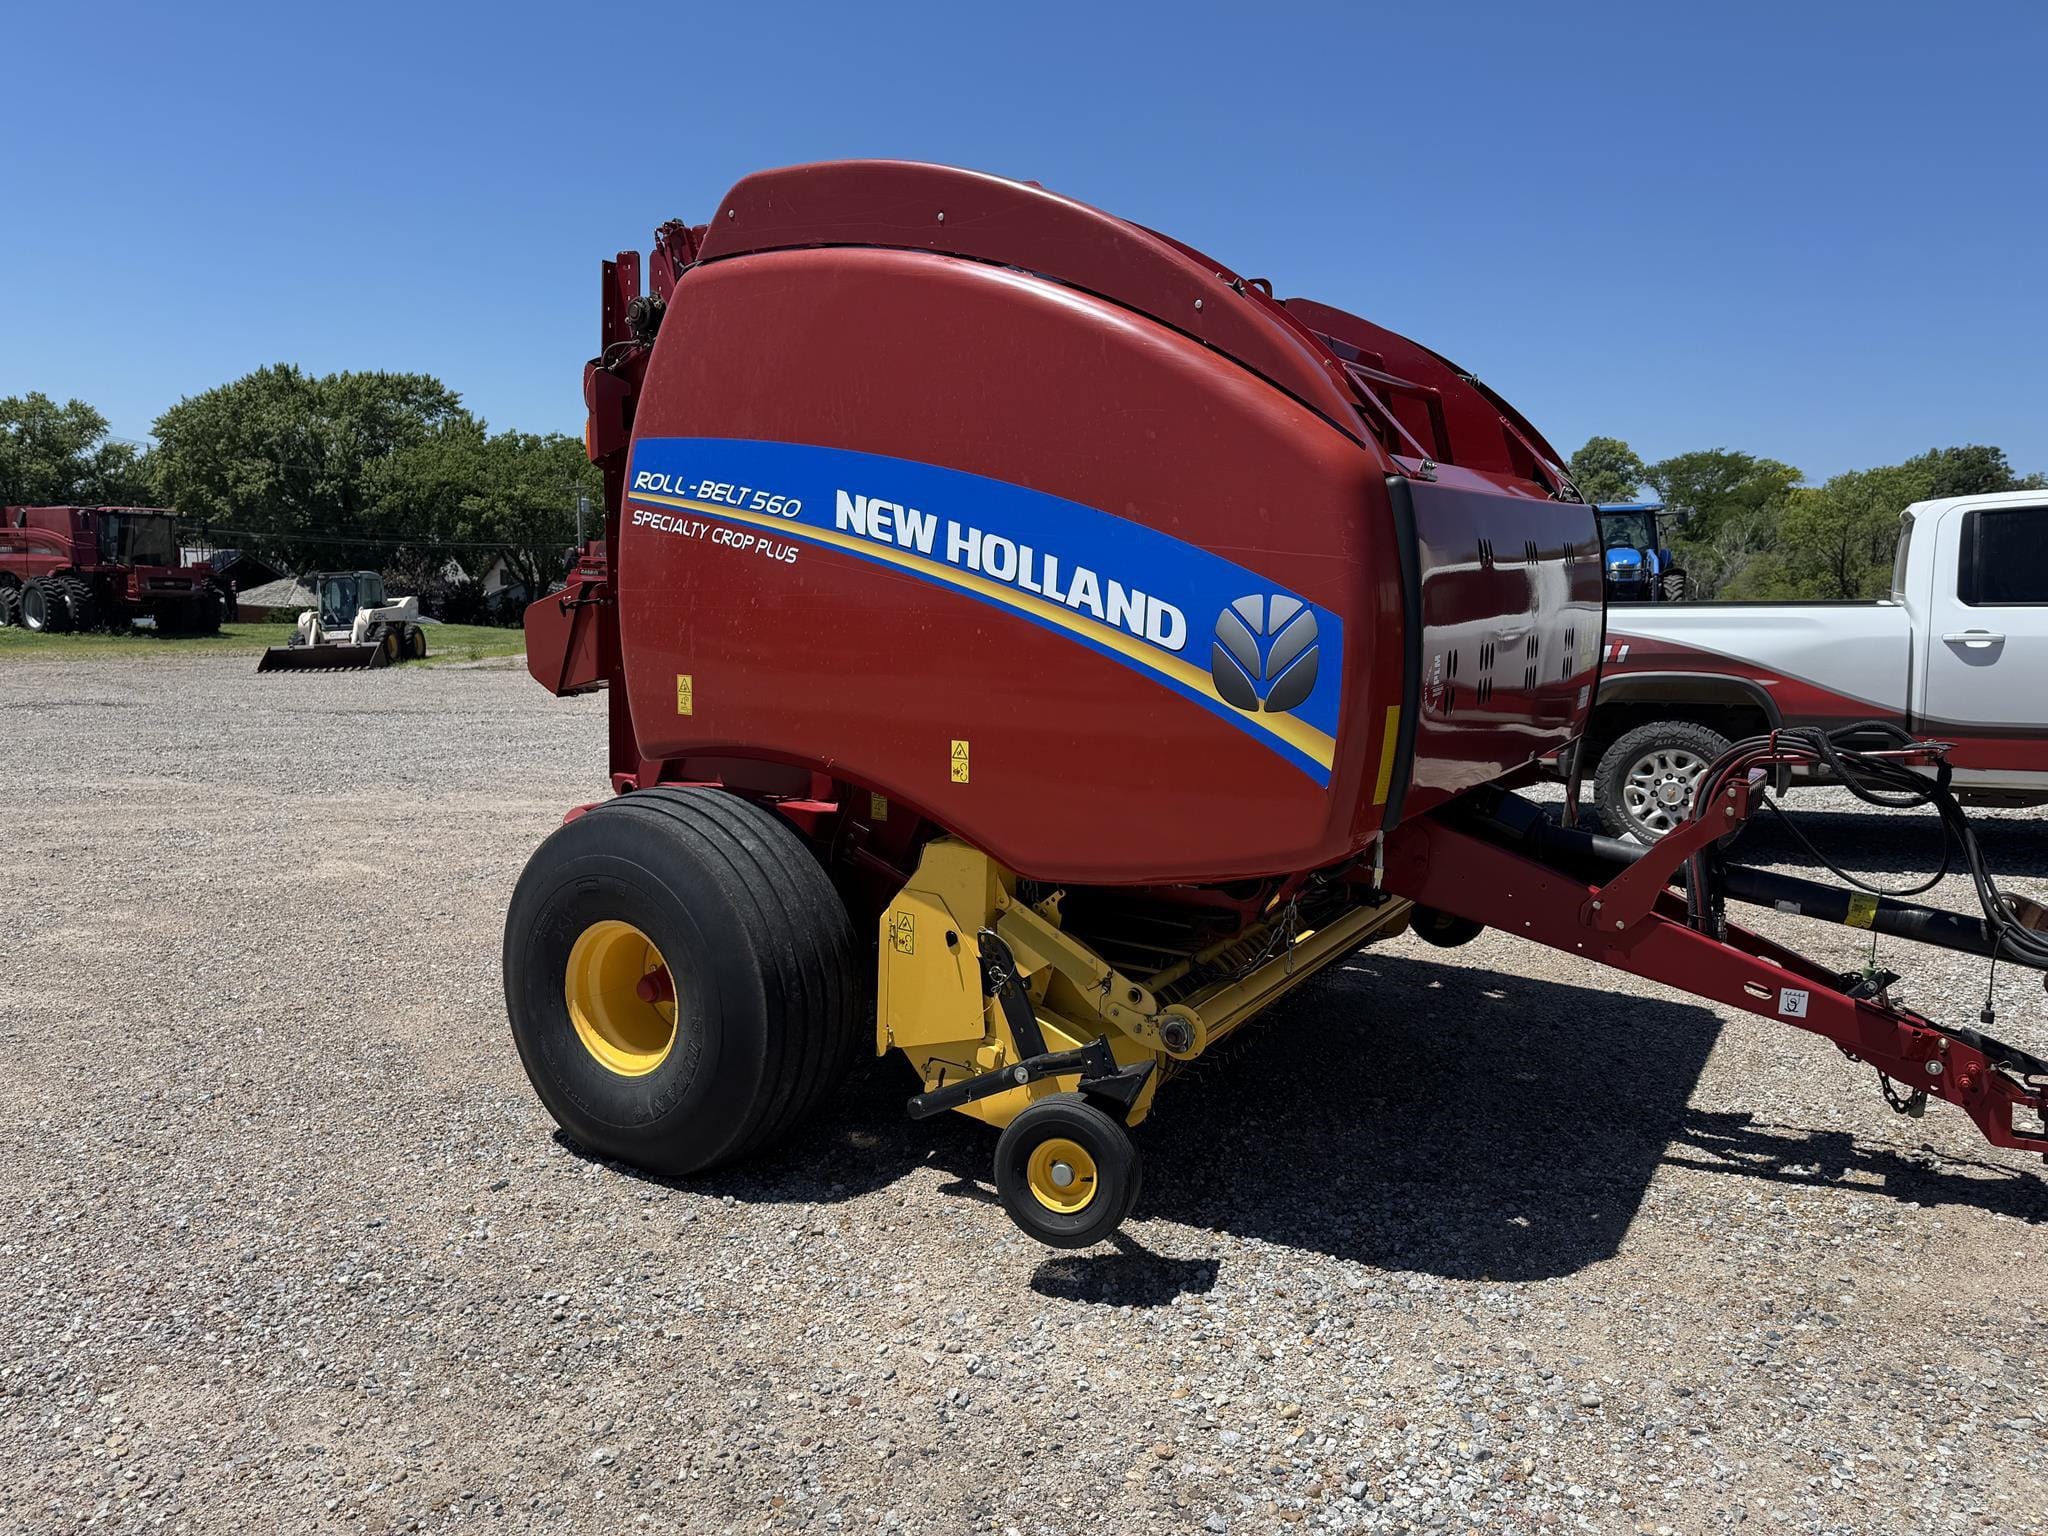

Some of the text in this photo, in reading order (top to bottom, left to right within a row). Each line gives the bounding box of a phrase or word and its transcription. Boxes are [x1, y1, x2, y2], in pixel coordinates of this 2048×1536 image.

[633, 470, 802, 518] ROLL-BELT 560
[631, 509, 799, 564] SPECIALTY CROP PLUS
[835, 488, 1188, 651] NEW HOLLAND
